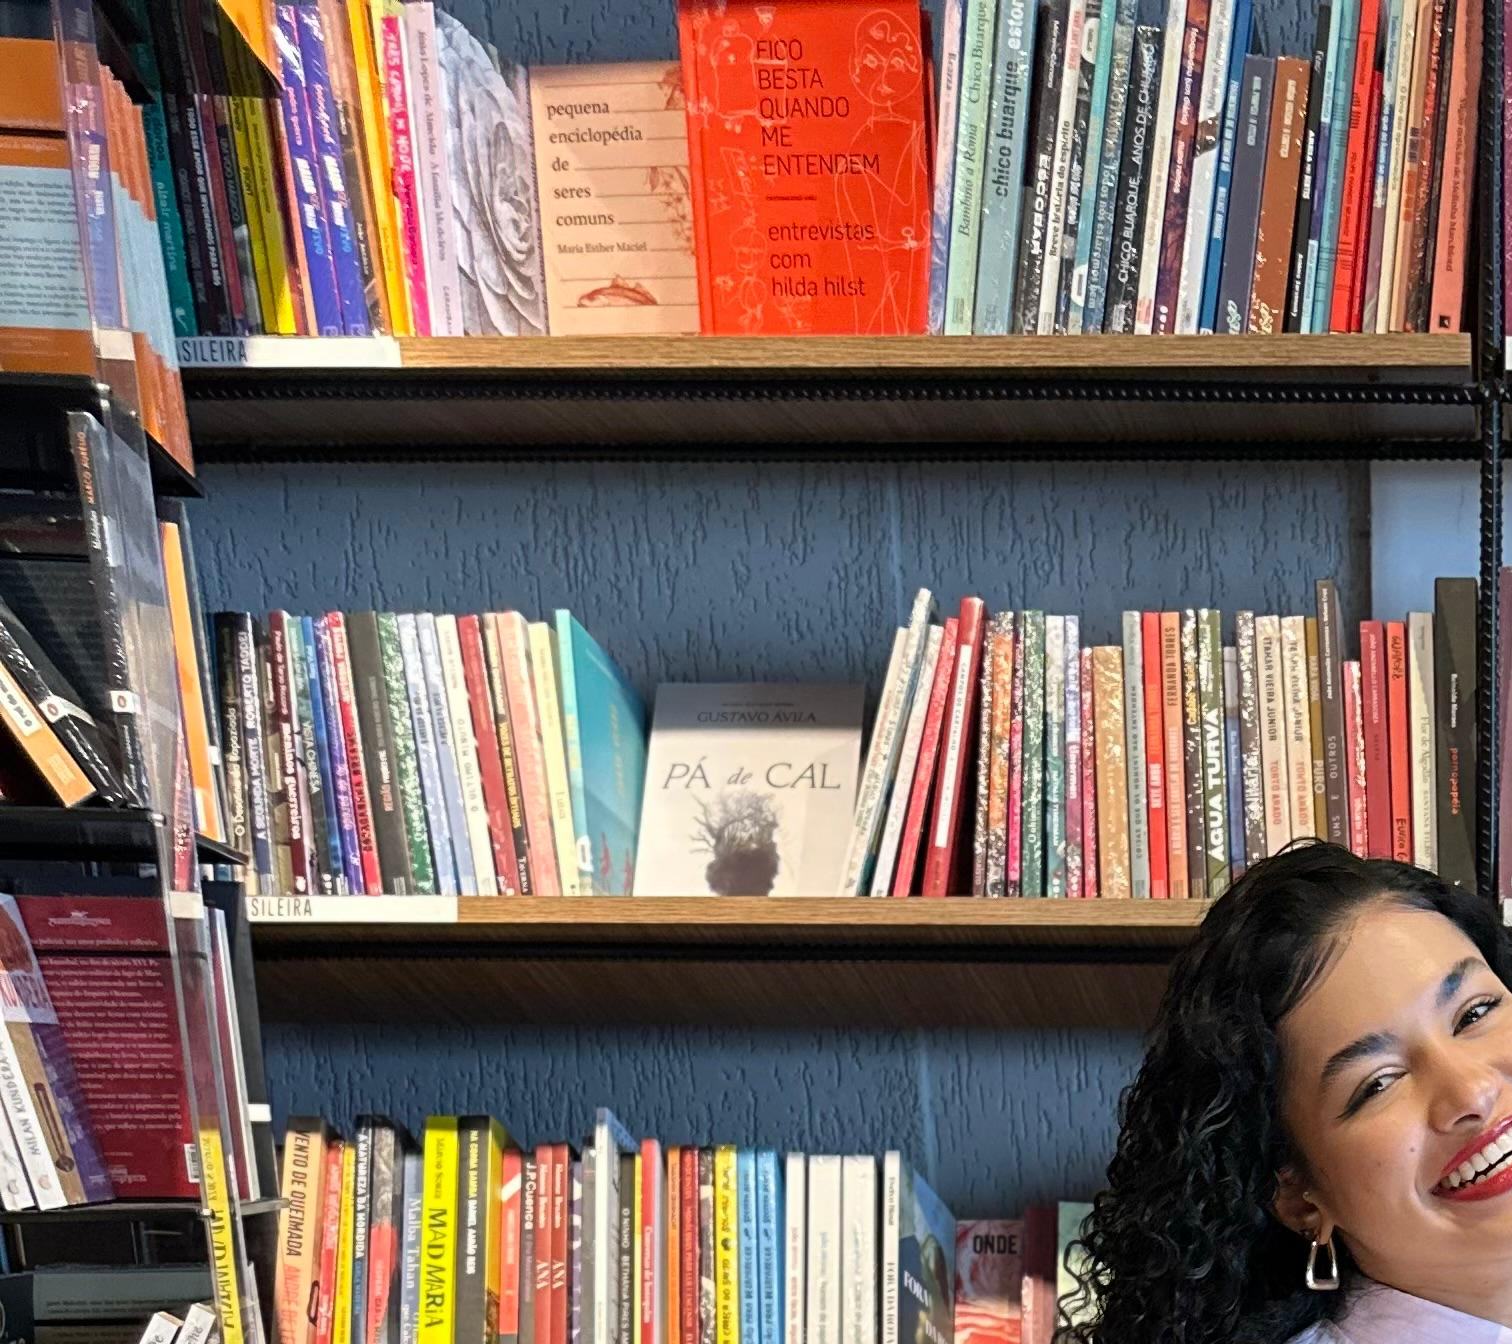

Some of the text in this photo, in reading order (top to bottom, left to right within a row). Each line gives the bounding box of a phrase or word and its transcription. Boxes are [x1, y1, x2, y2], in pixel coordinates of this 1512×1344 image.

[970, 1, 989, 59] Buarque
[756, 40, 802, 60] FICO
[758, 69, 824, 89] BESTA
[968, 61, 983, 105] Chico
[546, 101, 610, 120] pequena
[760, 97, 849, 119] QUANDO
[996, 61, 1021, 140] buarque
[1135, 105, 1148, 124] DE
[549, 125, 643, 145] enciclopédia
[762, 127, 793, 147] ME
[1131, 126, 1146, 165] ANOS
[552, 157, 570, 171] de
[763, 154, 880, 176] ENTENDEM
[992, 146, 1012, 198] chico
[554, 185, 591, 198] seres
[1123, 176, 1140, 239] BUARQUE
[556, 211, 614, 227] comuns
[768, 221, 875, 242] entrevistas
[557, 242, 585, 254] Maria
[770, 251, 812, 269] com
[1117, 241, 1132, 282] CHICO
[772, 276, 866, 297] hilda hilst
[1164, 626, 1178, 707] FERNANDA TORRES
[697, 709, 816, 723] GUSTAVO ÁVILA
[663, 756, 841, 789] PÁ de CAL
[1203, 707, 1225, 862] ÁGUA TURVA
[285, 1130, 311, 1257] VENTO DE QUEIMADA
[405, 1197, 422, 1289] Malba Tahan
[428, 1208, 448, 1259] MAD
[973, 1234, 1017, 1254] ONDE
[536, 1260, 549, 1289] ANA
[552, 1260, 564, 1289] ANA
